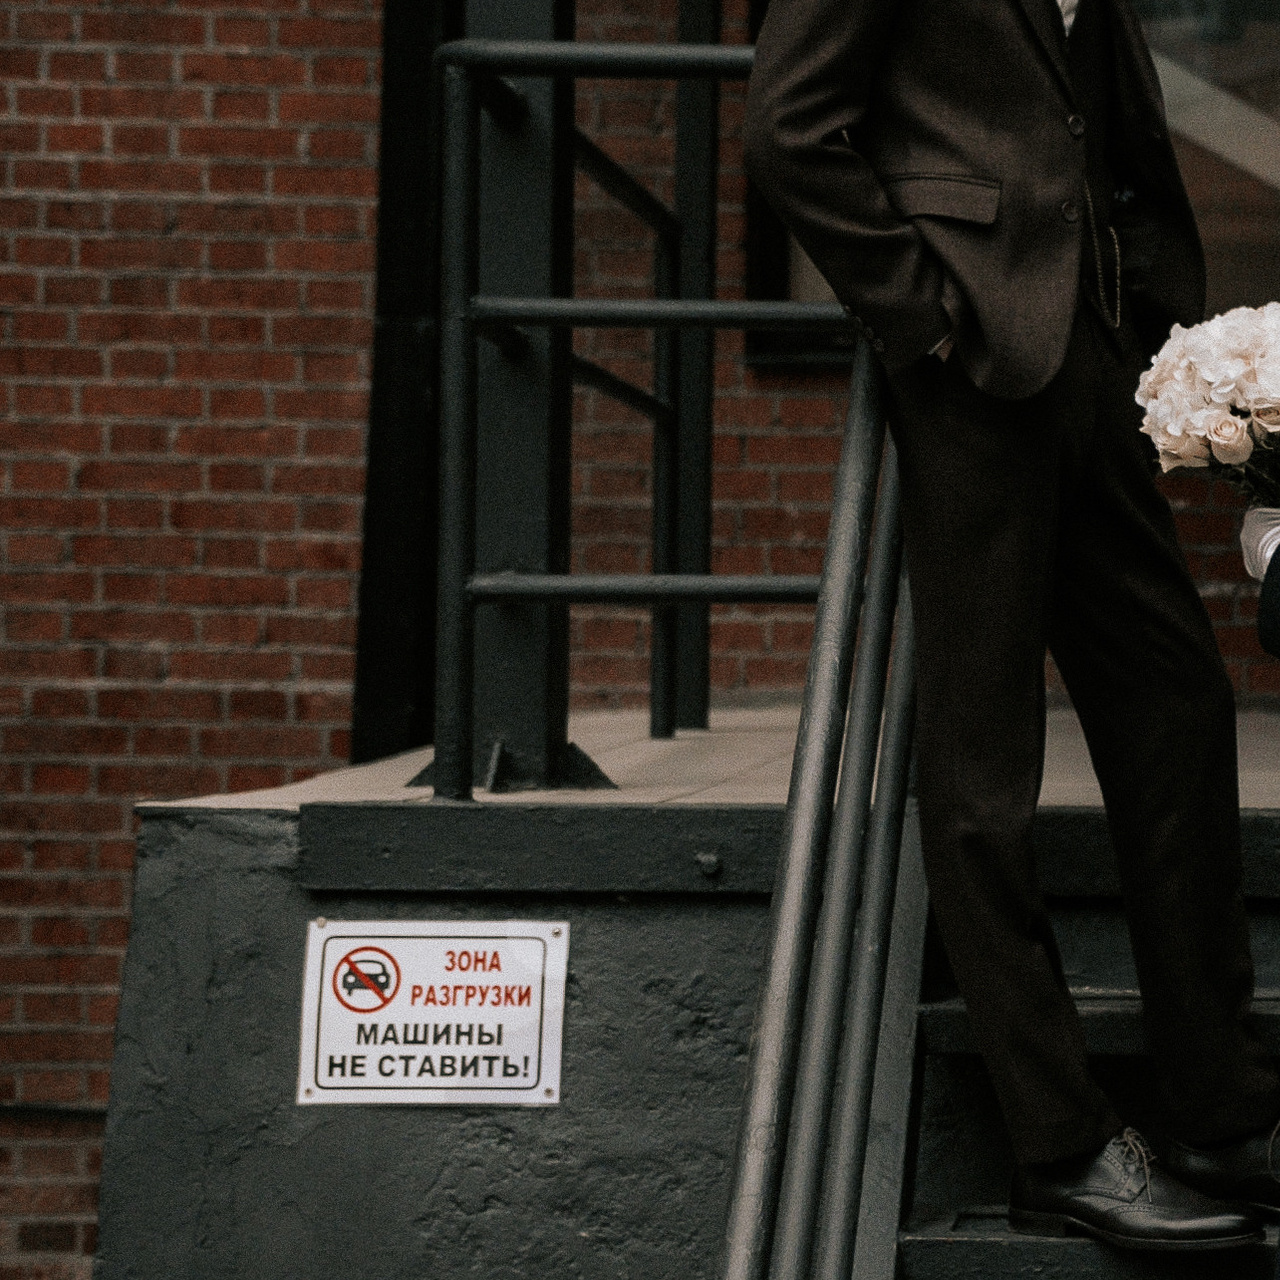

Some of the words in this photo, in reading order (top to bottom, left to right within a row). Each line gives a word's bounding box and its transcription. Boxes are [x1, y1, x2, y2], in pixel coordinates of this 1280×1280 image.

[444, 950, 502, 972] ЗОНА
[411, 984, 532, 1007] РАЗГРУЗКИ
[356, 1023, 503, 1046] МАШИНЫ
[328, 1055, 366, 1078] НЕ
[379, 1055, 530, 1078] СТАВИТЬ!
